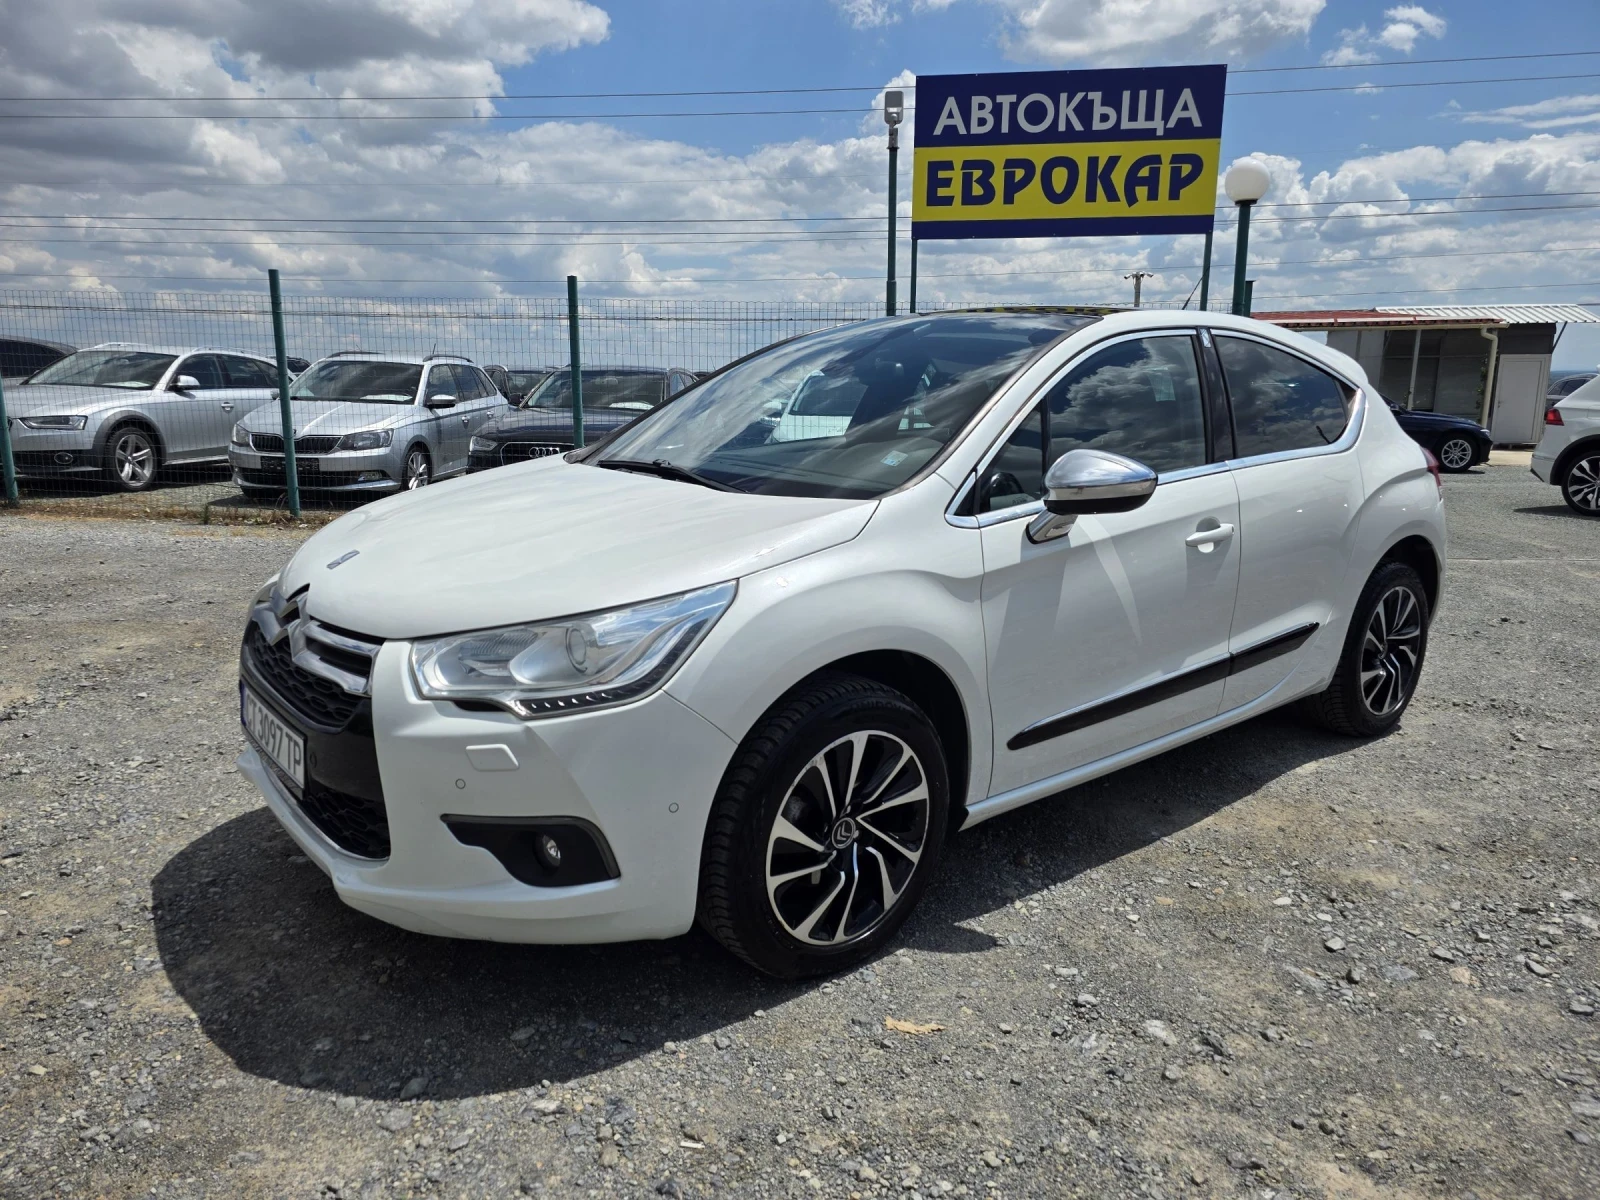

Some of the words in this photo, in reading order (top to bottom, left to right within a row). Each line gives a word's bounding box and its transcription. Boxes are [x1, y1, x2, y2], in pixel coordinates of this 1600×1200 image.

[932, 87, 1203, 137] АВТОКЪЩА
[925, 153, 1204, 208] ЕВРОКАР
[258, 706, 284, 760] 3097
[285, 731, 302, 776] TP
